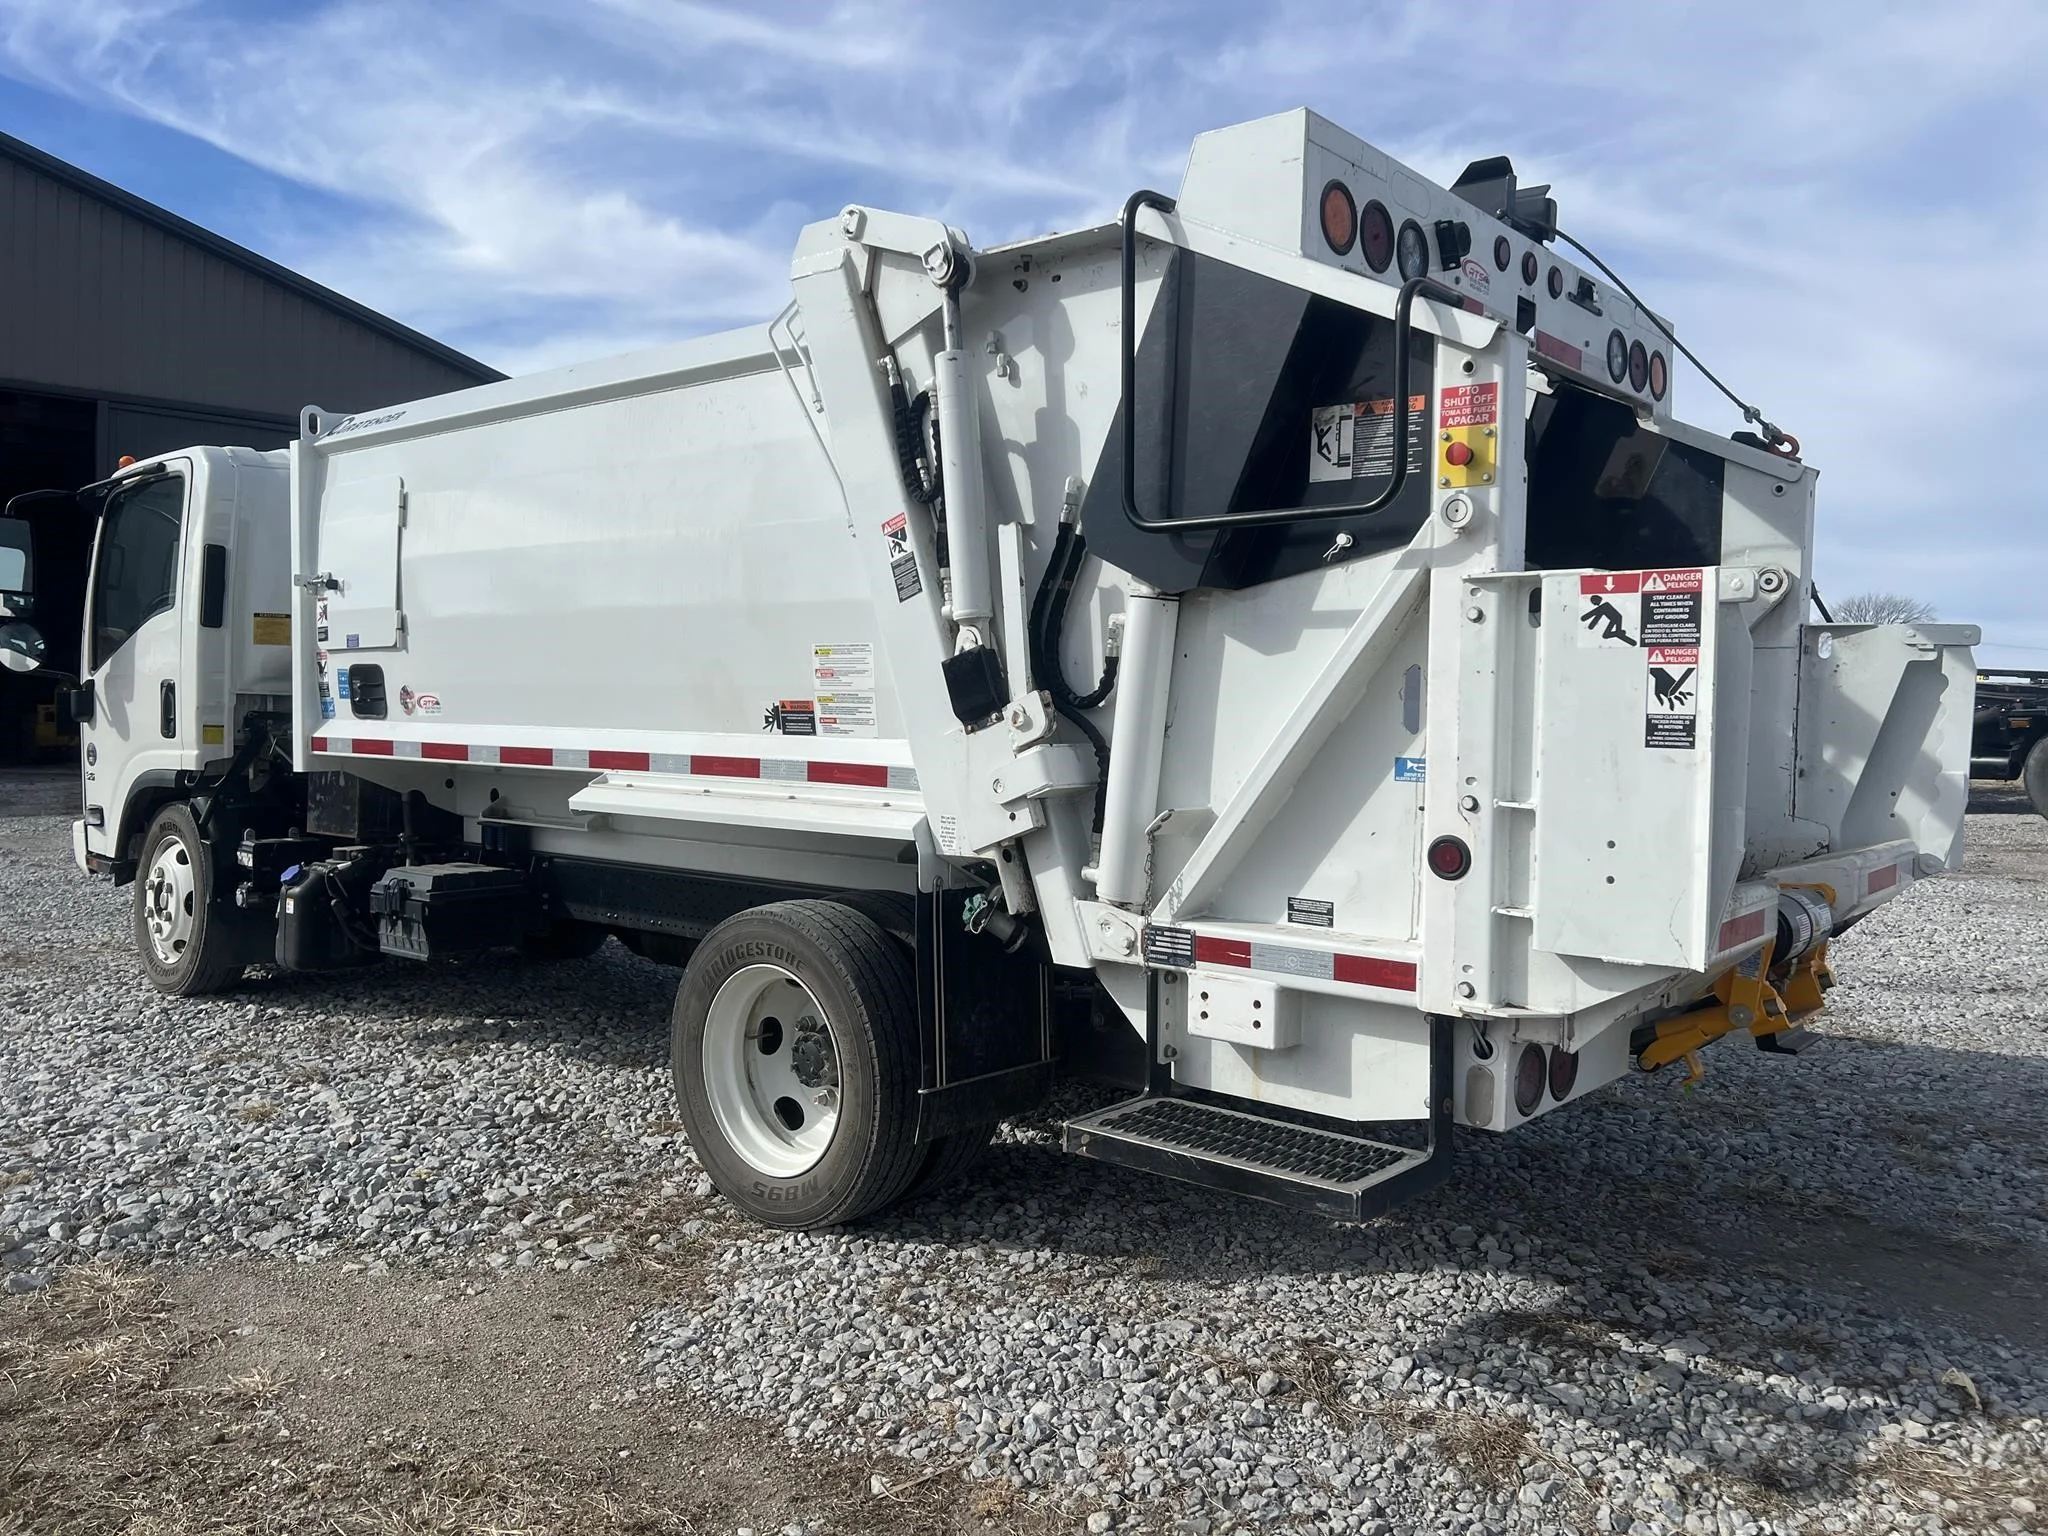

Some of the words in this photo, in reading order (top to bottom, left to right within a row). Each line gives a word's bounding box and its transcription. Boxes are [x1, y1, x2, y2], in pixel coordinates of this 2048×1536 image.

[1459, 386, 1479, 396] PTO
[1444, 396, 1471, 407] SHUT
[1473, 394, 1494, 404] OFF
[1447, 414, 1489, 426] APAGAR
[1664, 573, 1701, 581] DANGER
[701, 942, 808, 992] BRIDGESTONE
[751, 1174, 819, 1201] M895
